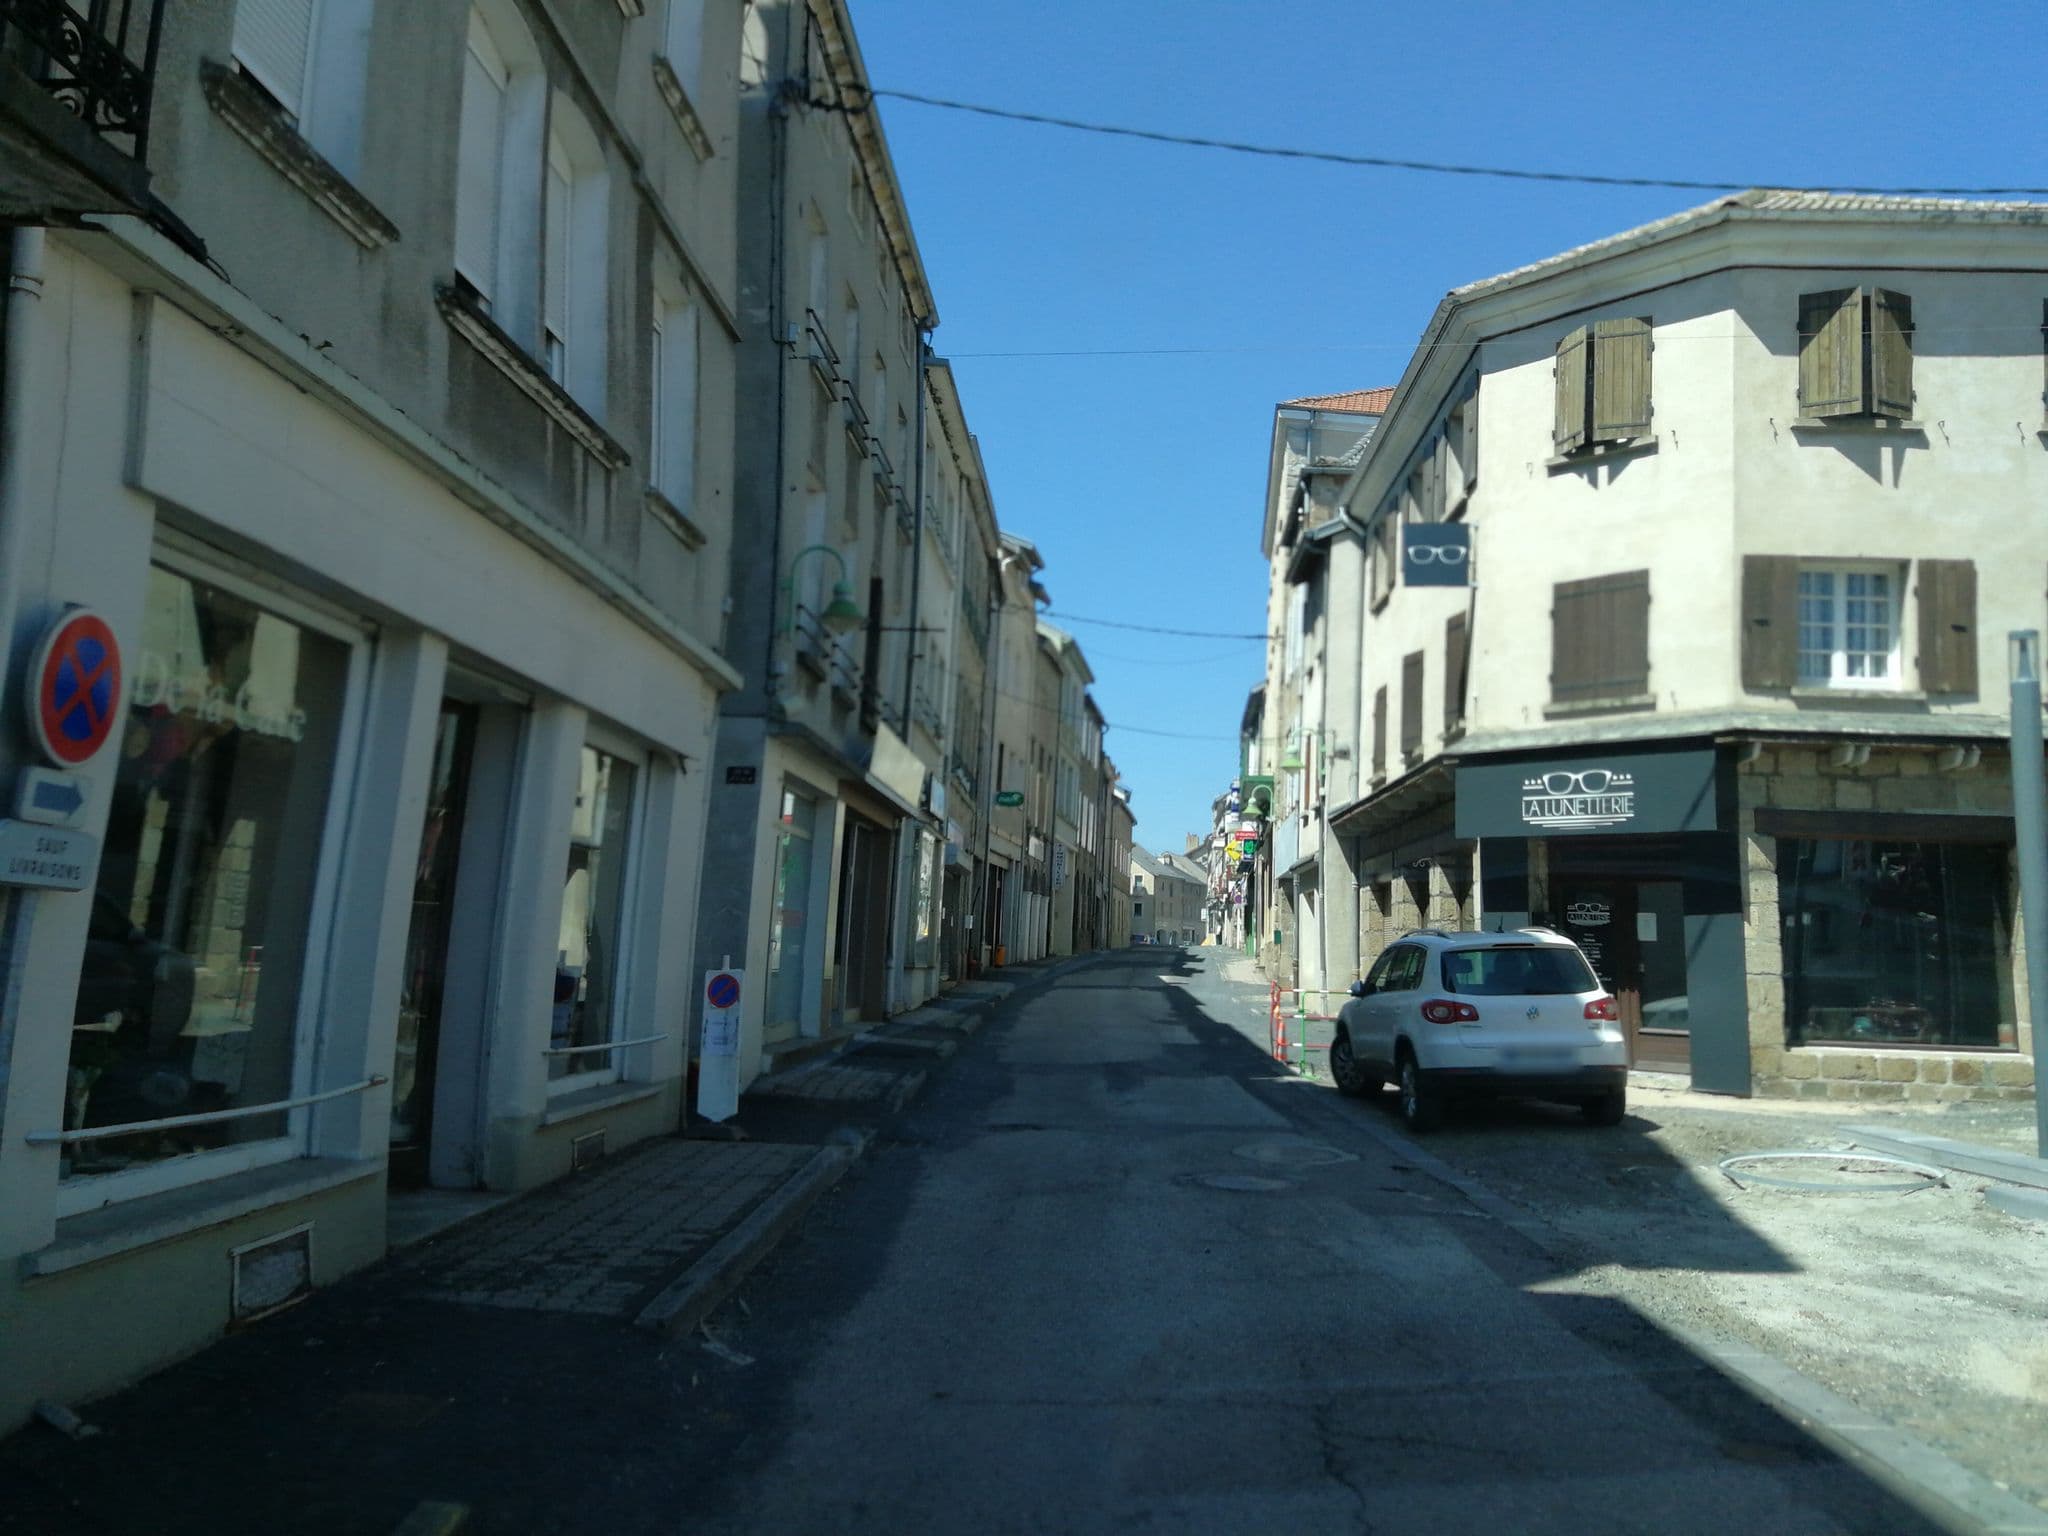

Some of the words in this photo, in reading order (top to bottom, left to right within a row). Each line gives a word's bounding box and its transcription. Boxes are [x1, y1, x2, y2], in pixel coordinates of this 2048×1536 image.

[1522, 799, 1541, 817] LA
[1544, 796, 1634, 816] LUNETTERIE
[36, 837, 69, 855] SAUF
[8, 857, 81, 881] LIVRAISONS
